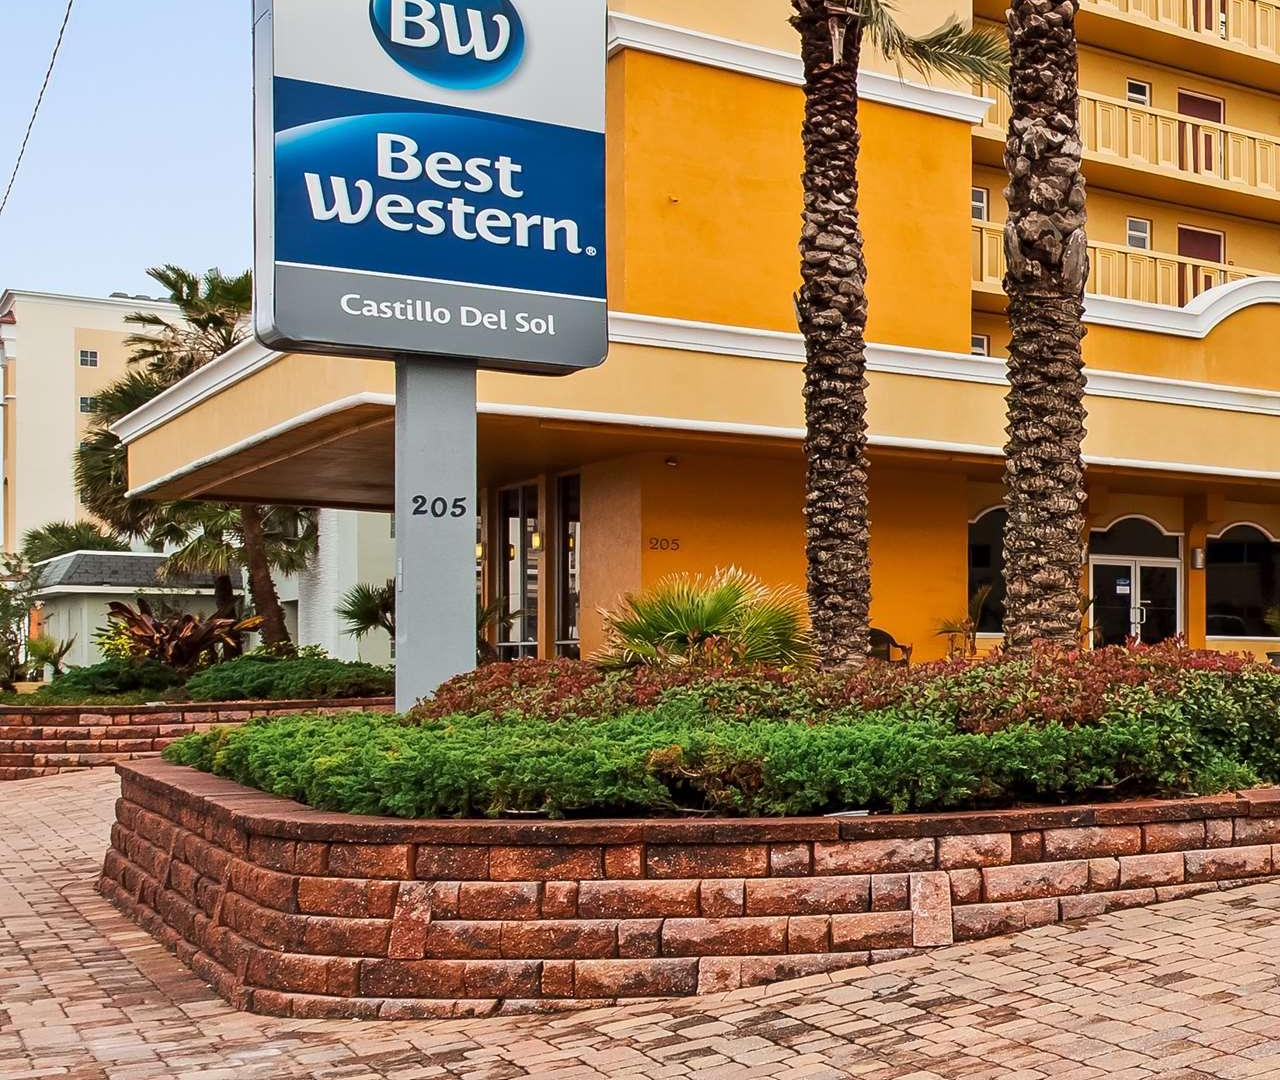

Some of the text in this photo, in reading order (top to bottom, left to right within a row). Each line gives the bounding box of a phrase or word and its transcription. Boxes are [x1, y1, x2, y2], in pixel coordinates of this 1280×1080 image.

[376, 132, 524, 198] Best
[340, 293, 556, 336] Castillo Del Sol
[411, 495, 467, 518] 205
[649, 537, 681, 551] 205
